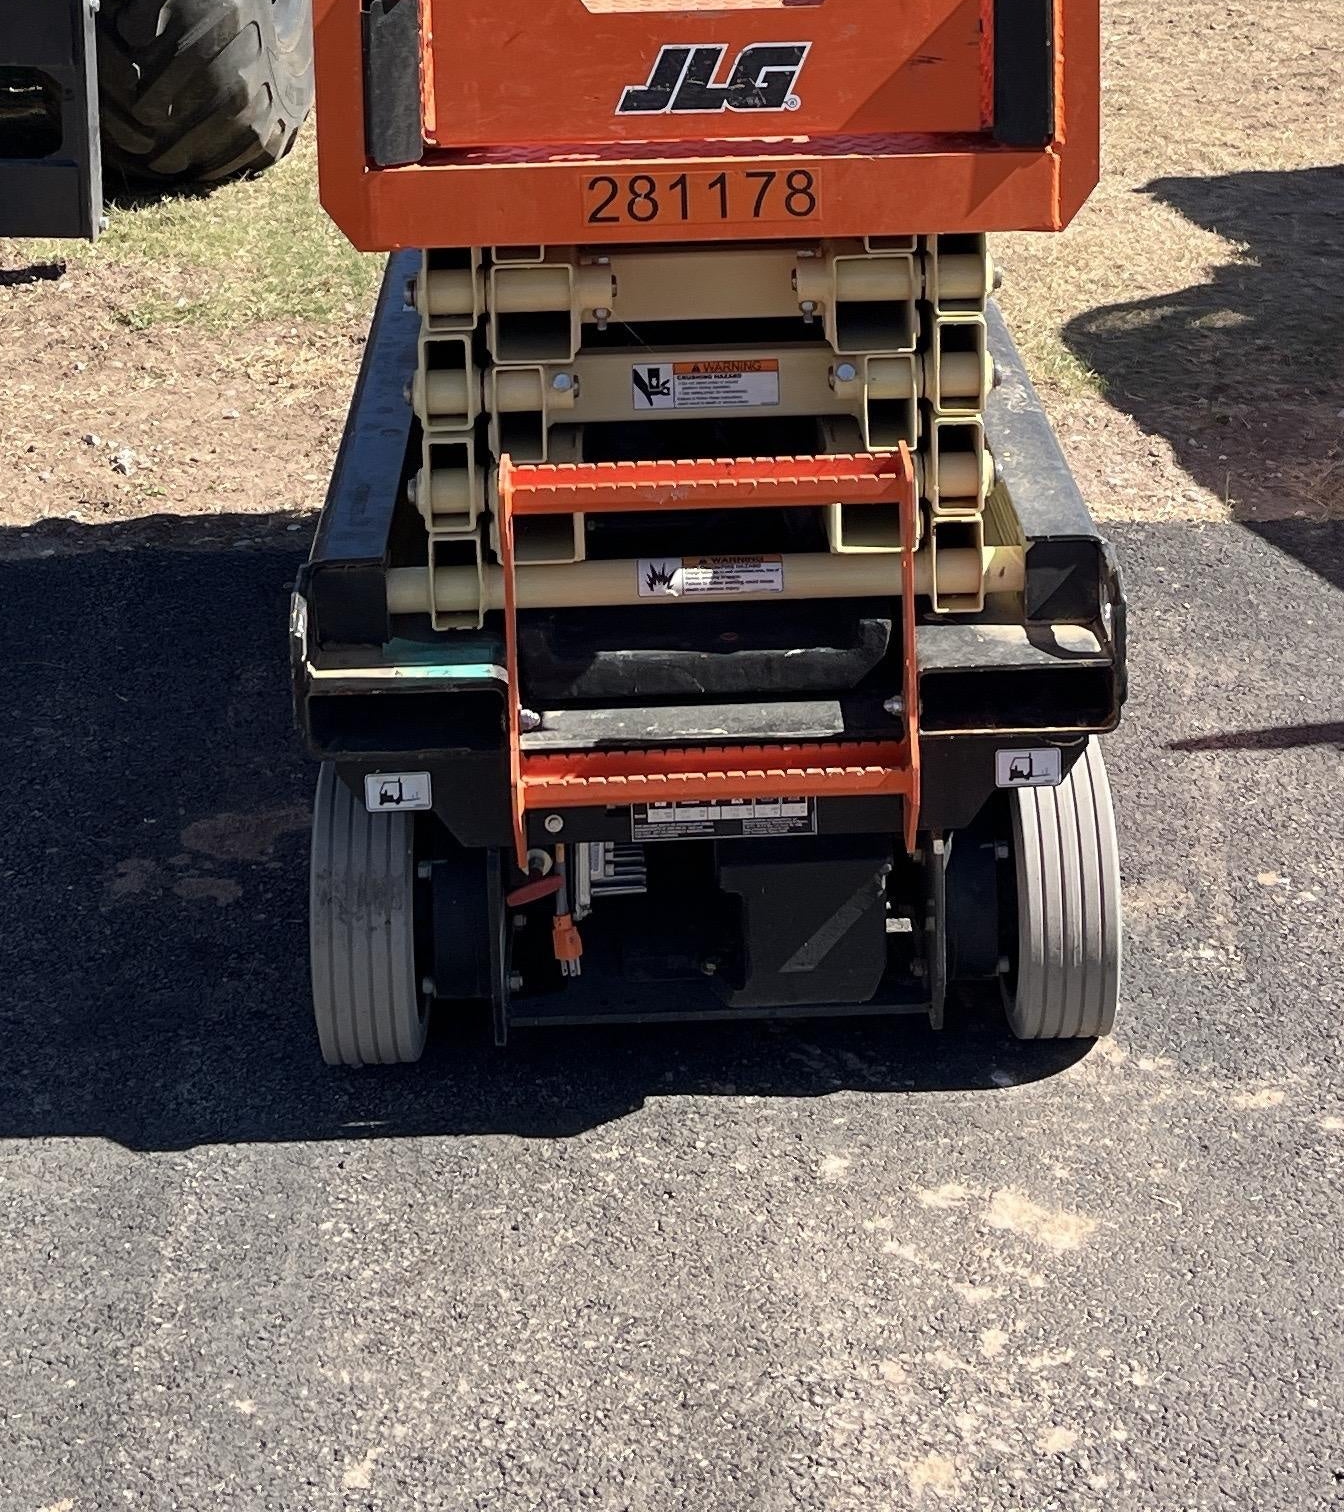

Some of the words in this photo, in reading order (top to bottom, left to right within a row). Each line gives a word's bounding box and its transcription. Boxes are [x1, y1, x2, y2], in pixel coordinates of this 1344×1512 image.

[614, 41, 813, 116] JLG
[587, 169, 817, 224] 281178
[703, 360, 762, 372] WARNING
[711, 556, 764, 564] WARNING
